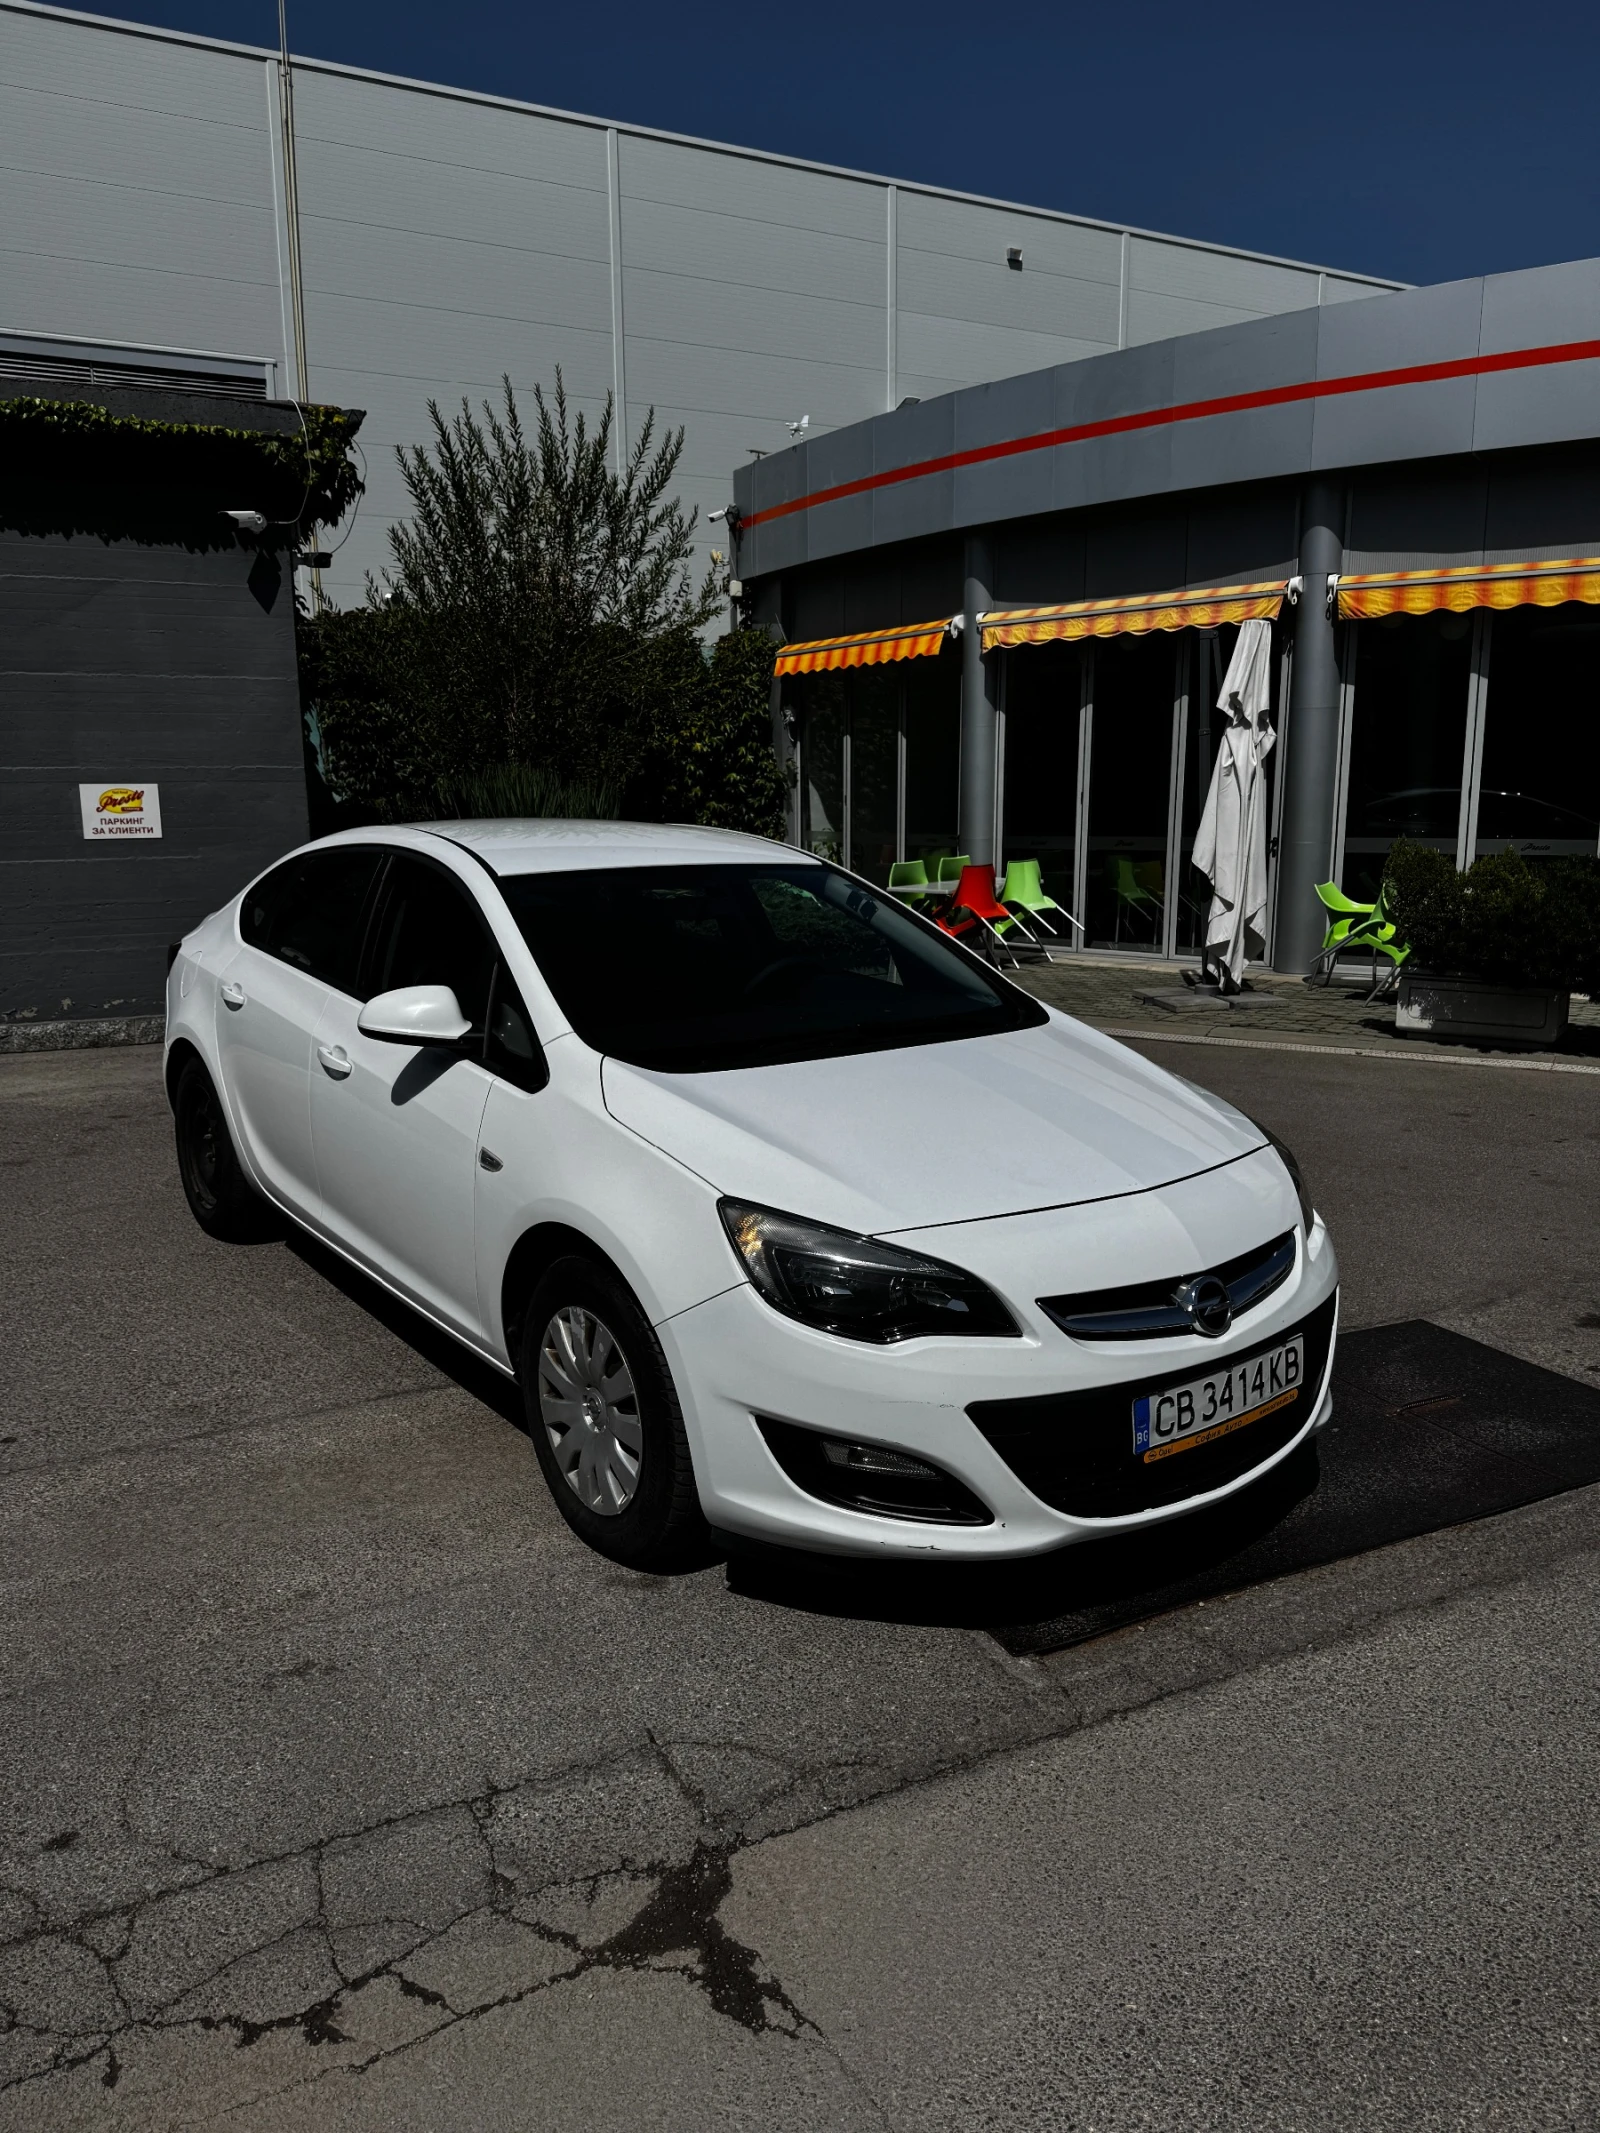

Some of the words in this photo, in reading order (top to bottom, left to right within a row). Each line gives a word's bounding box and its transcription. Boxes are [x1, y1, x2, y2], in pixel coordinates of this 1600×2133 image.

[96, 790, 144, 812] Presto
[100, 817, 144, 825] ПАРКИНГ
[92, 827, 105, 835] ЗА
[108, 826, 154, 835] КЛИЕНТИ
[1521, 842, 1551, 851] Presto
[1136, 1430, 1149, 1445] BG
[1195, 1426, 1222, 1445] София
[1224, 1419, 1243, 1434] Ауто
